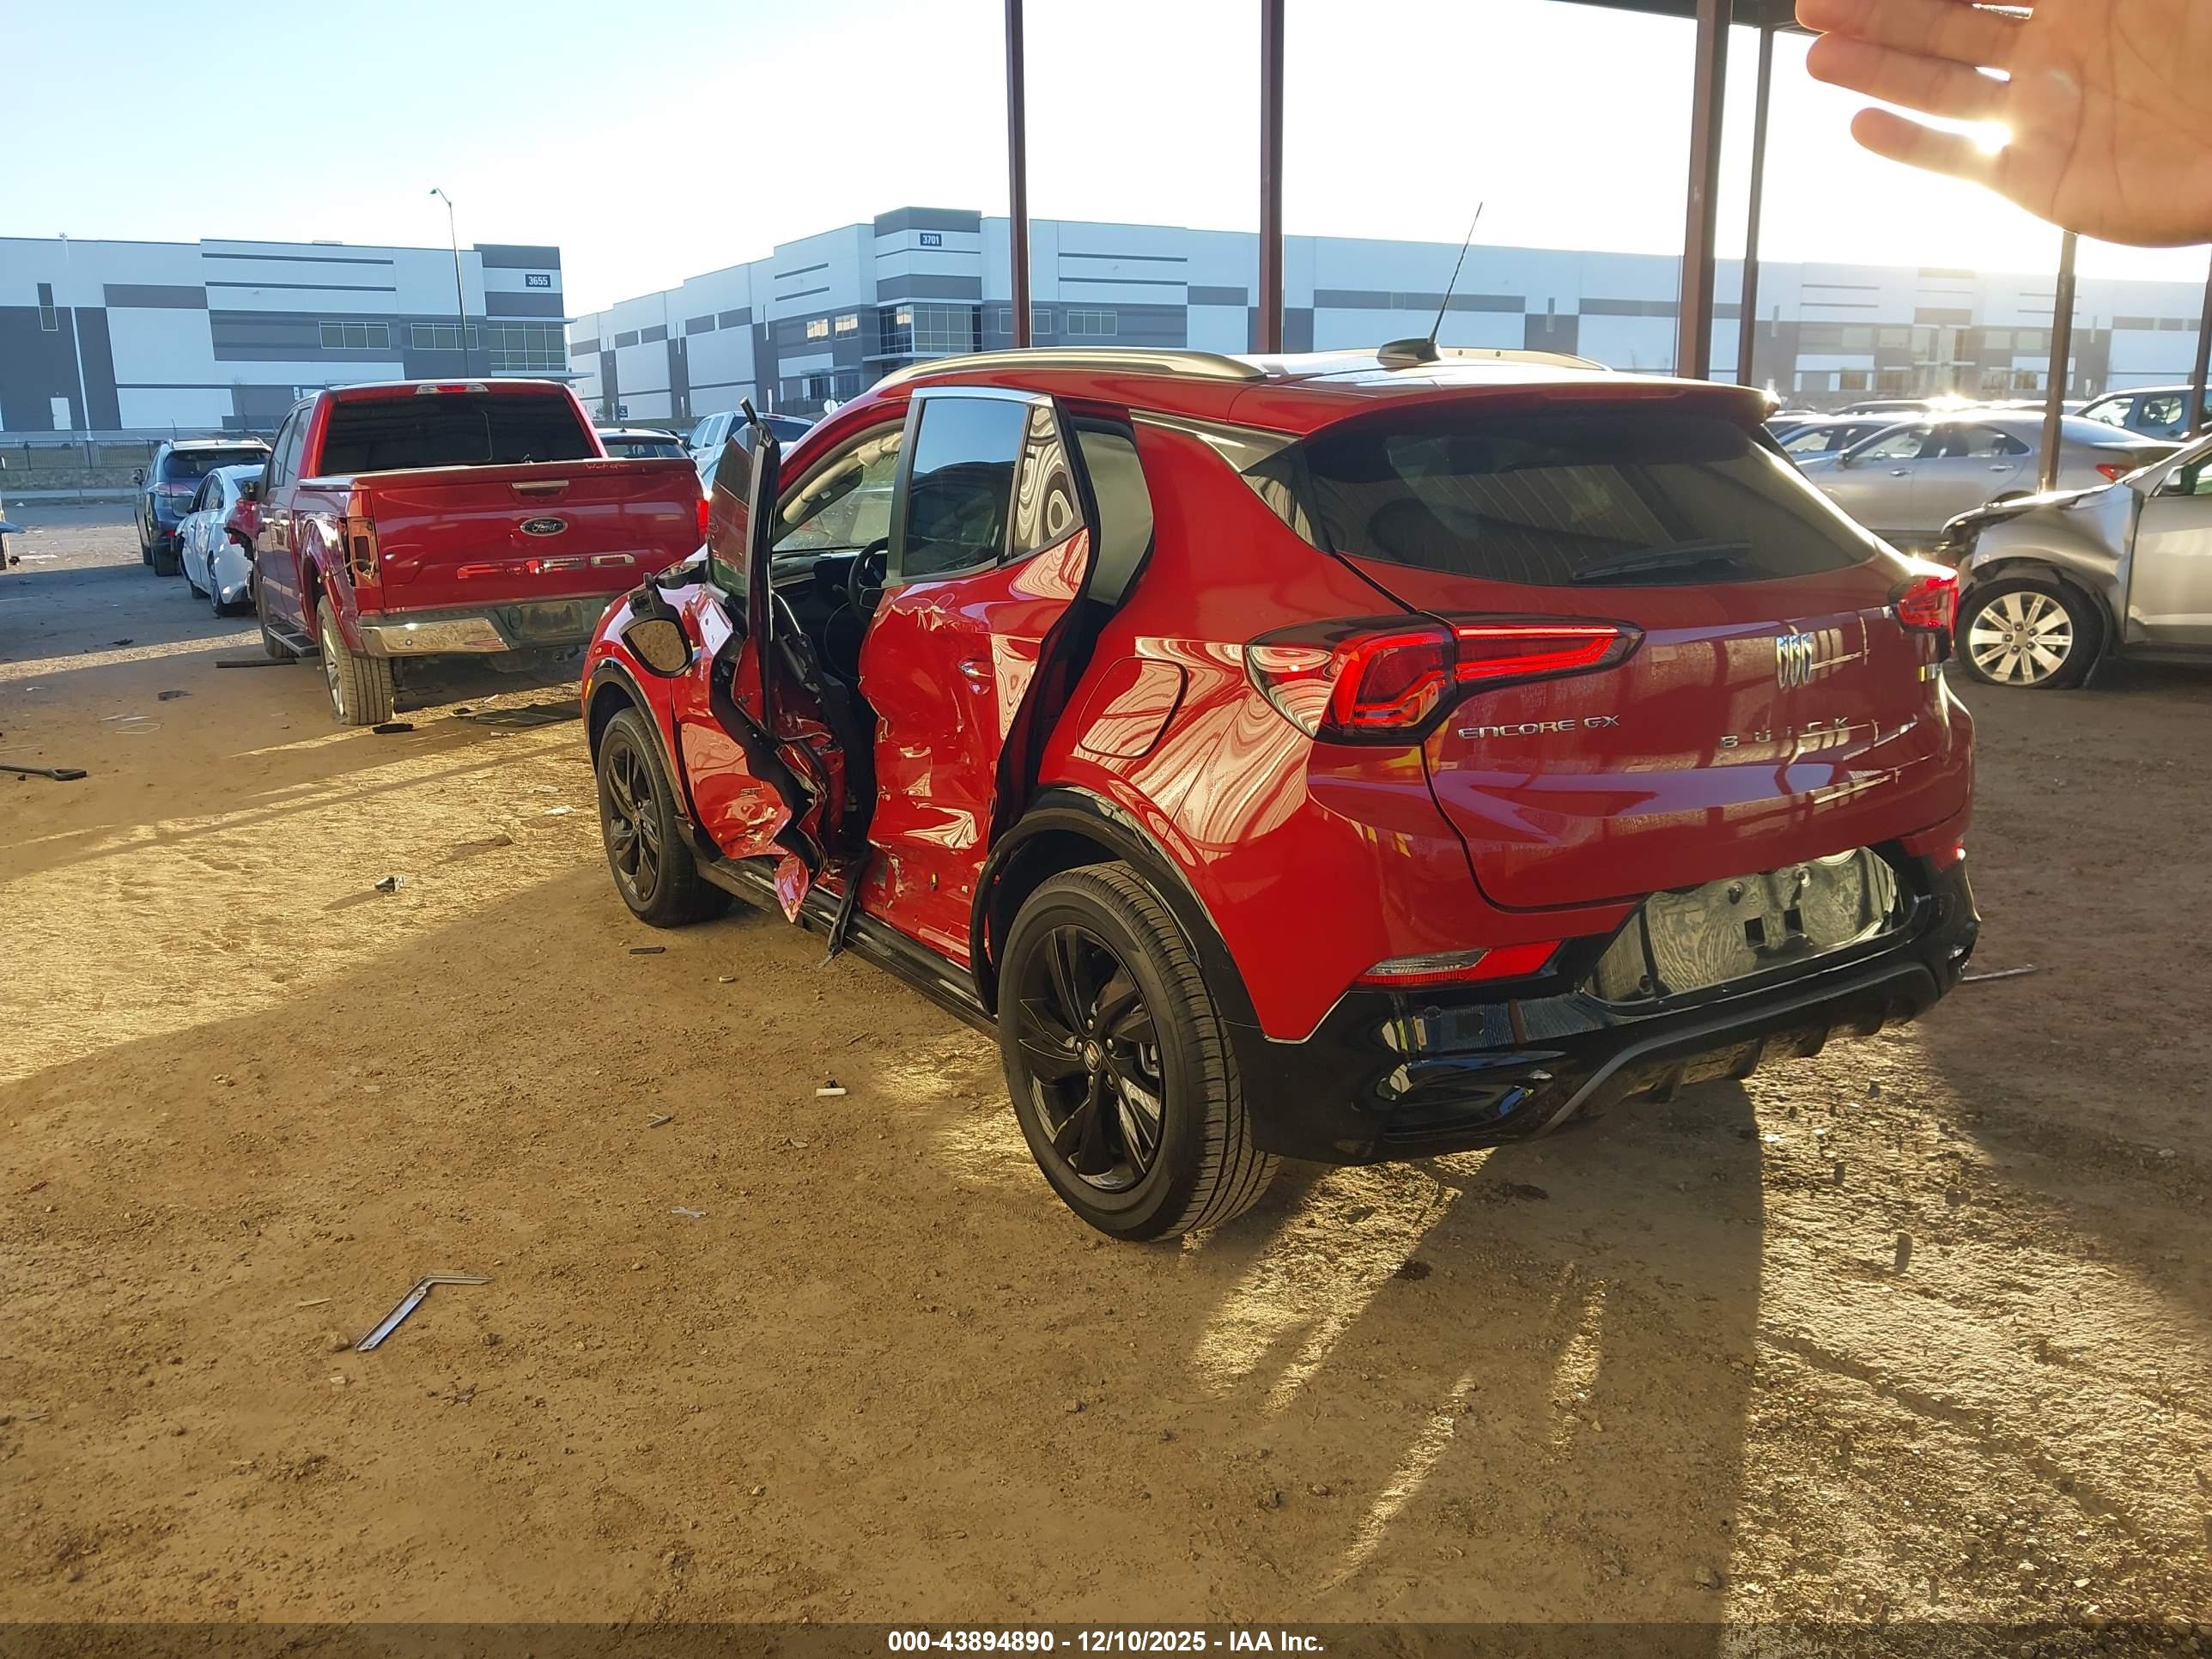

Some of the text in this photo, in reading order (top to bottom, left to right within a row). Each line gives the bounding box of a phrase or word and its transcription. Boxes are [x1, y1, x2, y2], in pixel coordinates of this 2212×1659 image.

[922, 234, 939, 245] 3701
[528, 276, 549, 286] 3655
[532, 520, 557, 532] Ford
[1457, 714, 1620, 739] ENCORE GX
[1721, 716, 1849, 749] BUICK
